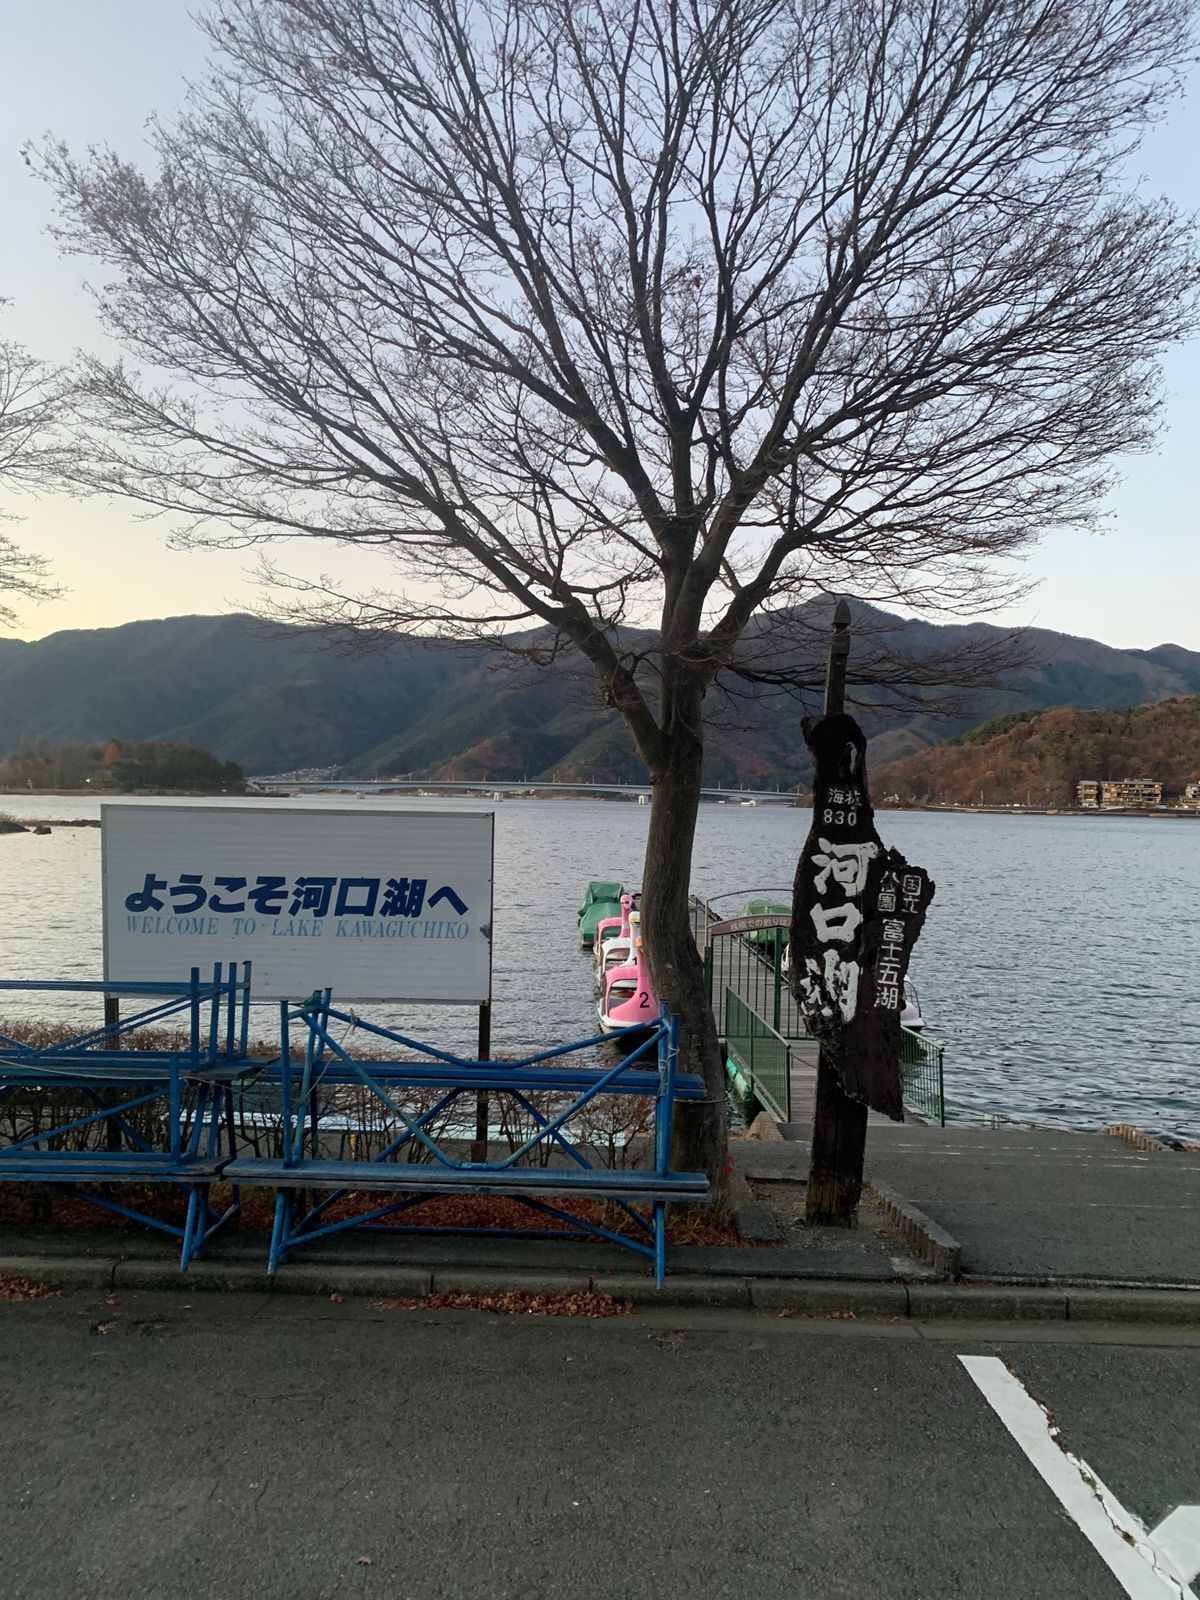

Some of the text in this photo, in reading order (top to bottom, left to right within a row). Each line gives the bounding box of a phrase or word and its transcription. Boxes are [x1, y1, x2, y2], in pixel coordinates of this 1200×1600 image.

[823, 808, 857, 827] 830
[125, 873, 469, 918] ようこそ河口湖へ
[126, 916, 470, 940] WELCOME TO LAKE KAWAGUCHIKO
[800, 837, 879, 1022] 河口湖
[874, 918, 906, 1010] 富士五湖
[639, 991, 650, 1008] 2
